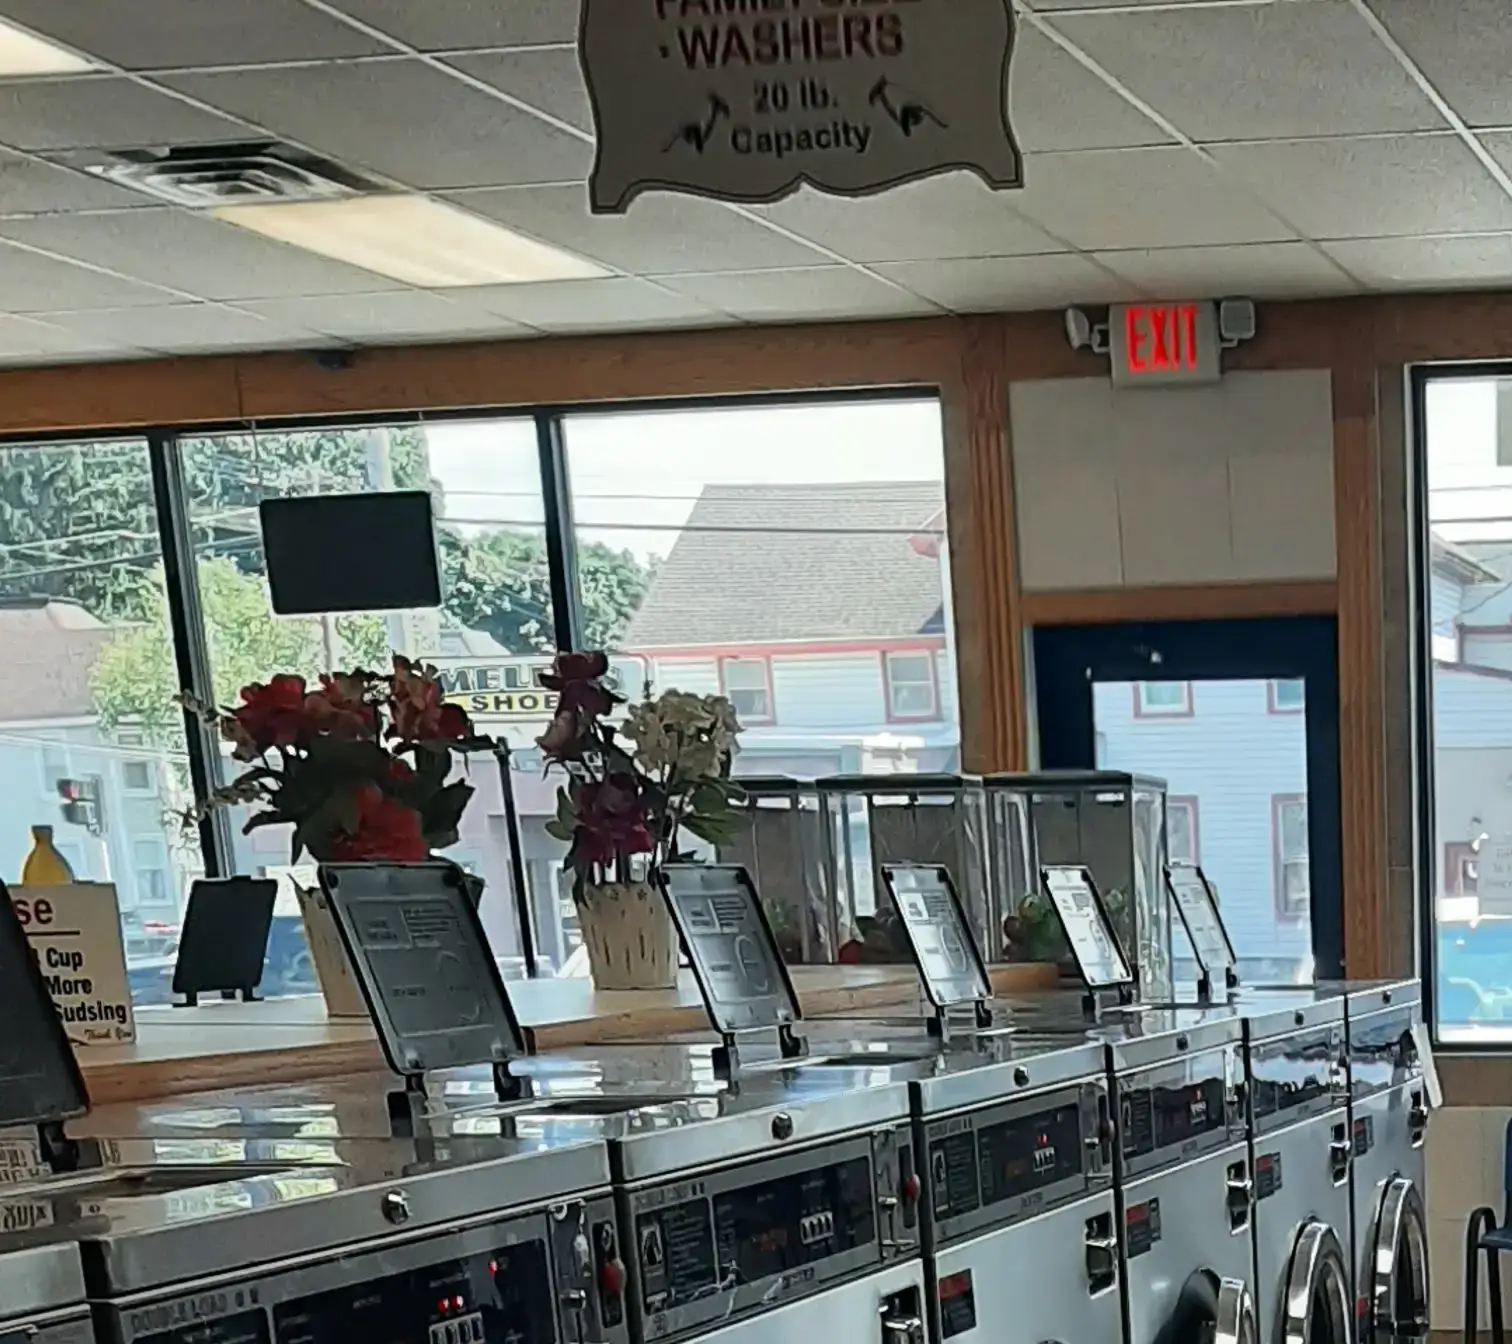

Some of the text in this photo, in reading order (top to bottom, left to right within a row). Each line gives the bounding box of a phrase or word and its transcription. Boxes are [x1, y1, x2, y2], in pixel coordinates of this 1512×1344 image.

[677, 13, 904, 70] WASHERS
[753, 78, 838, 113] 20 lb.
[731, 120, 871, 159] Capacity
[1126, 306, 1196, 373] EXIT
[46, 947, 83, 971] Cup
[43, 974, 93, 995] More
